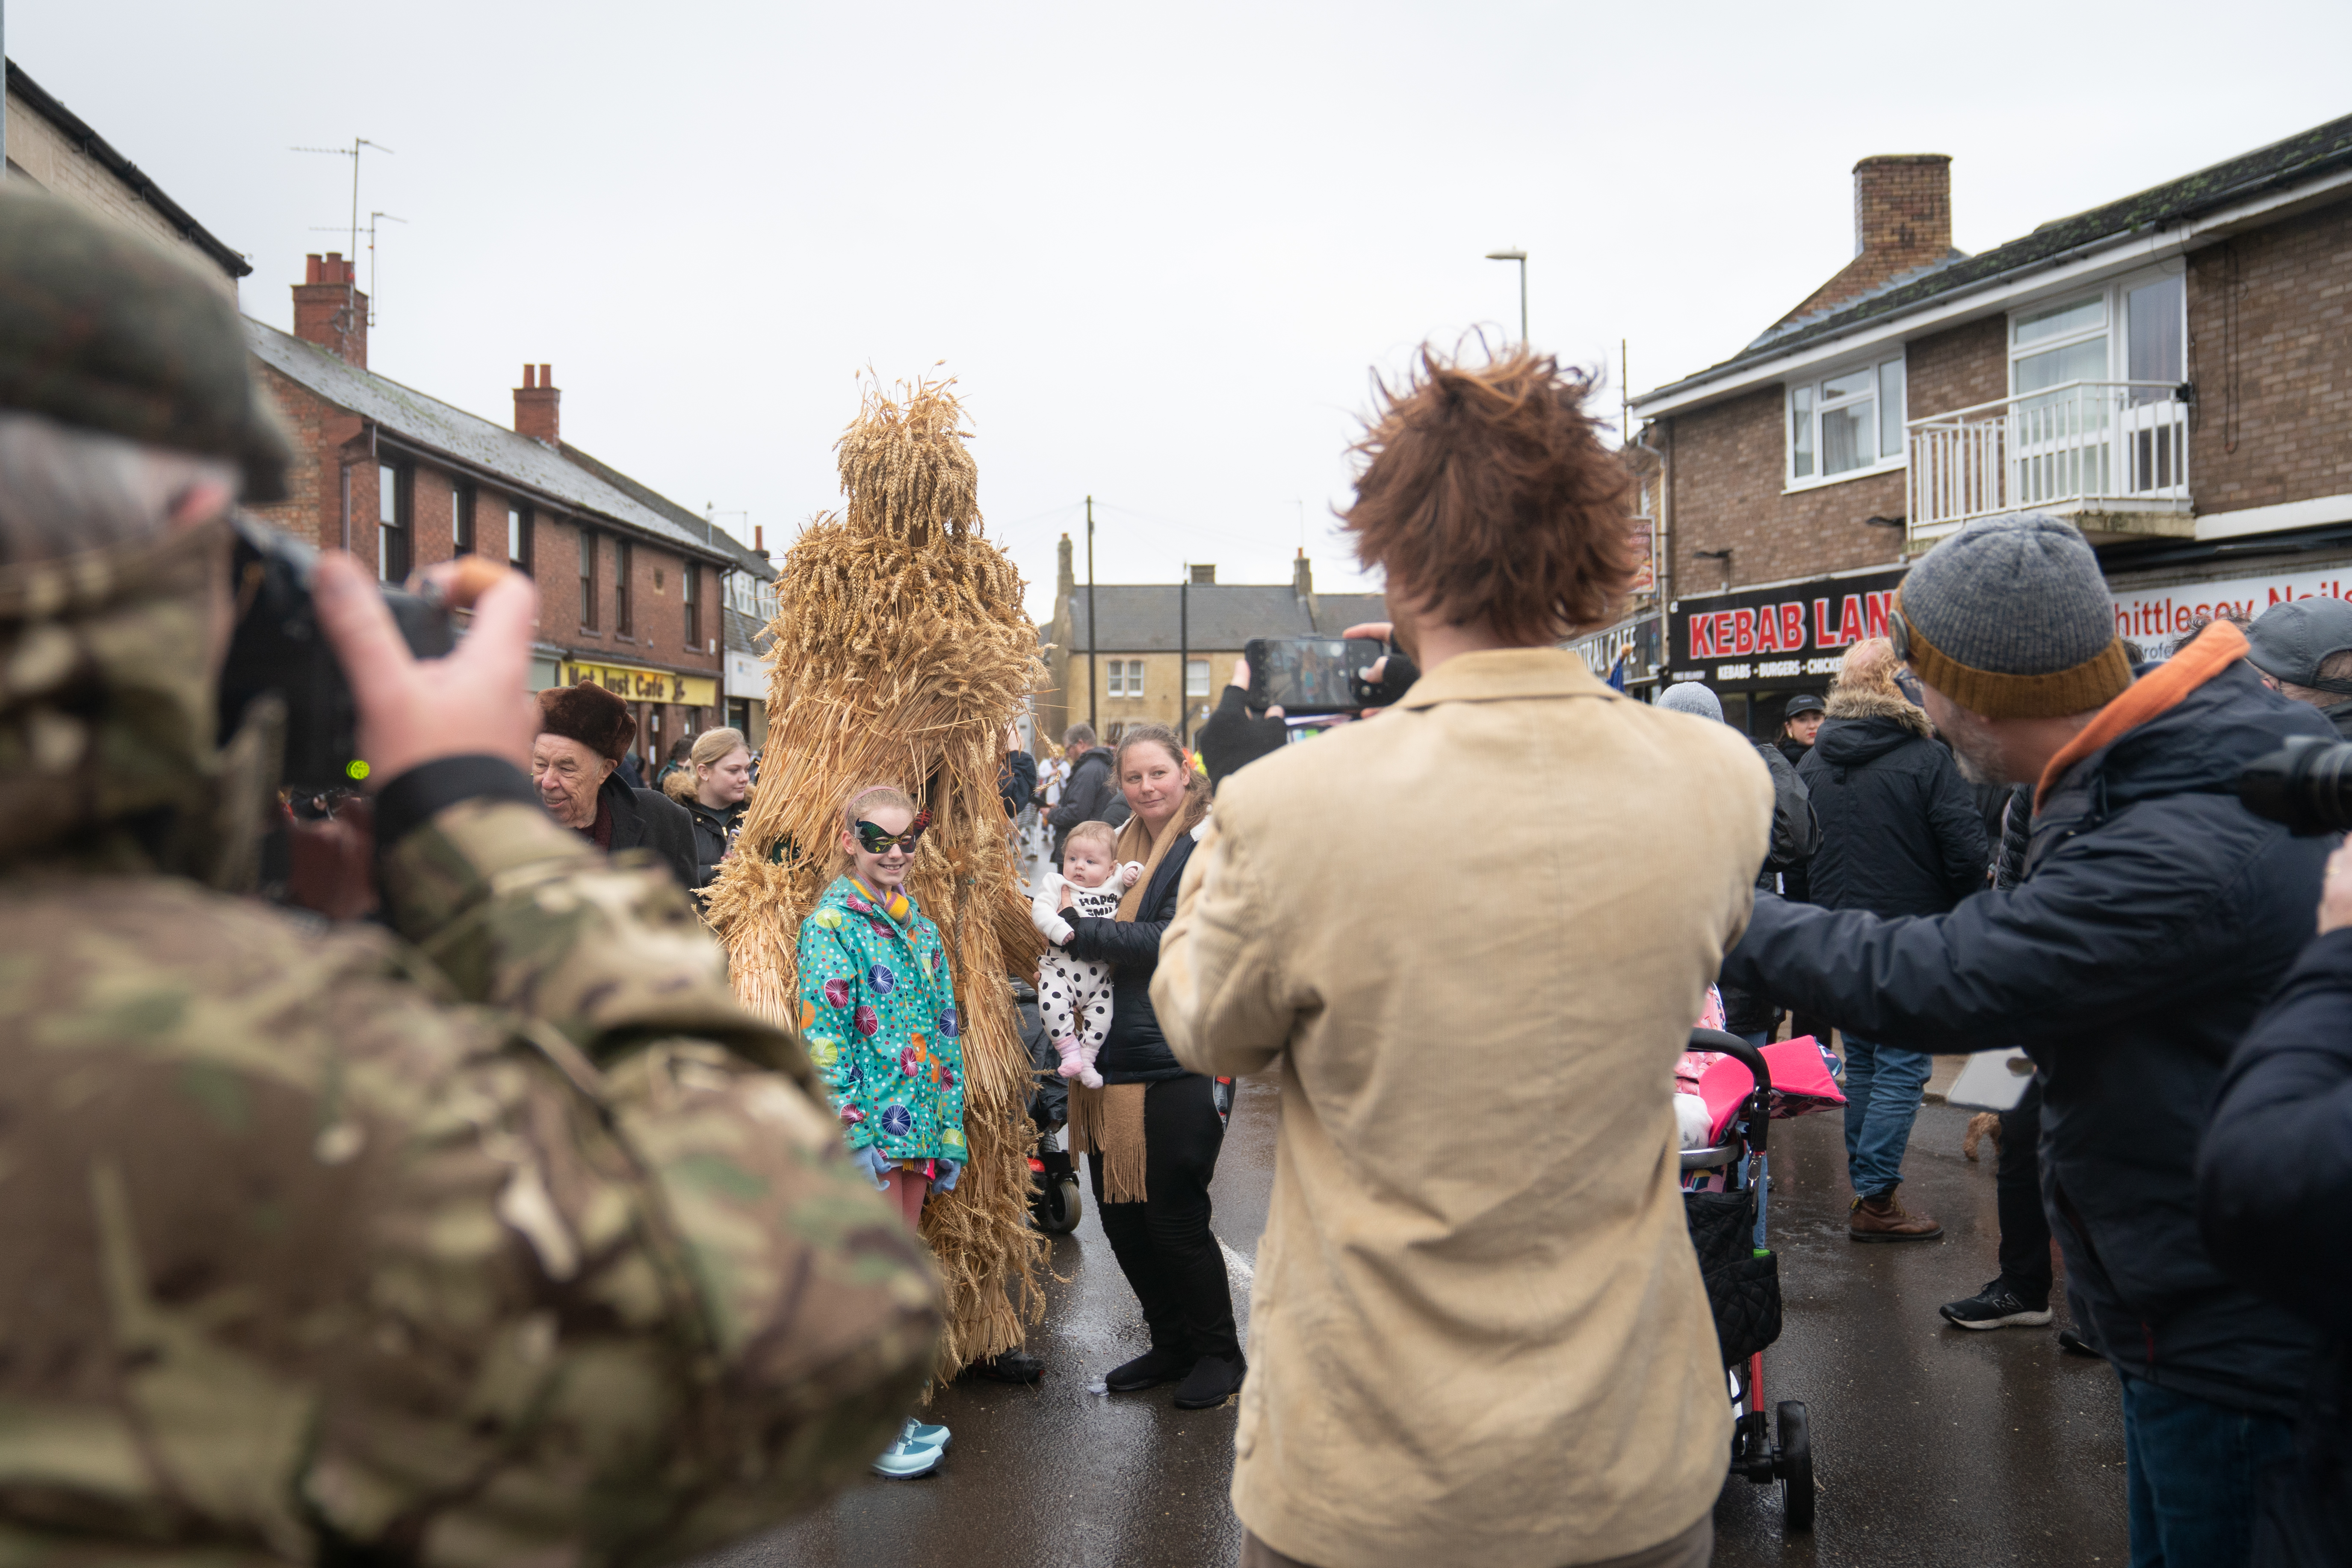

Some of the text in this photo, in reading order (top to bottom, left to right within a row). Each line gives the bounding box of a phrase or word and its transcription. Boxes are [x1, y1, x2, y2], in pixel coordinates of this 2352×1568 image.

[1690, 589, 1895, 659] KEBAB LAN
[1717, 657, 1844, 681] KEBABS BURGERS CHICKE
